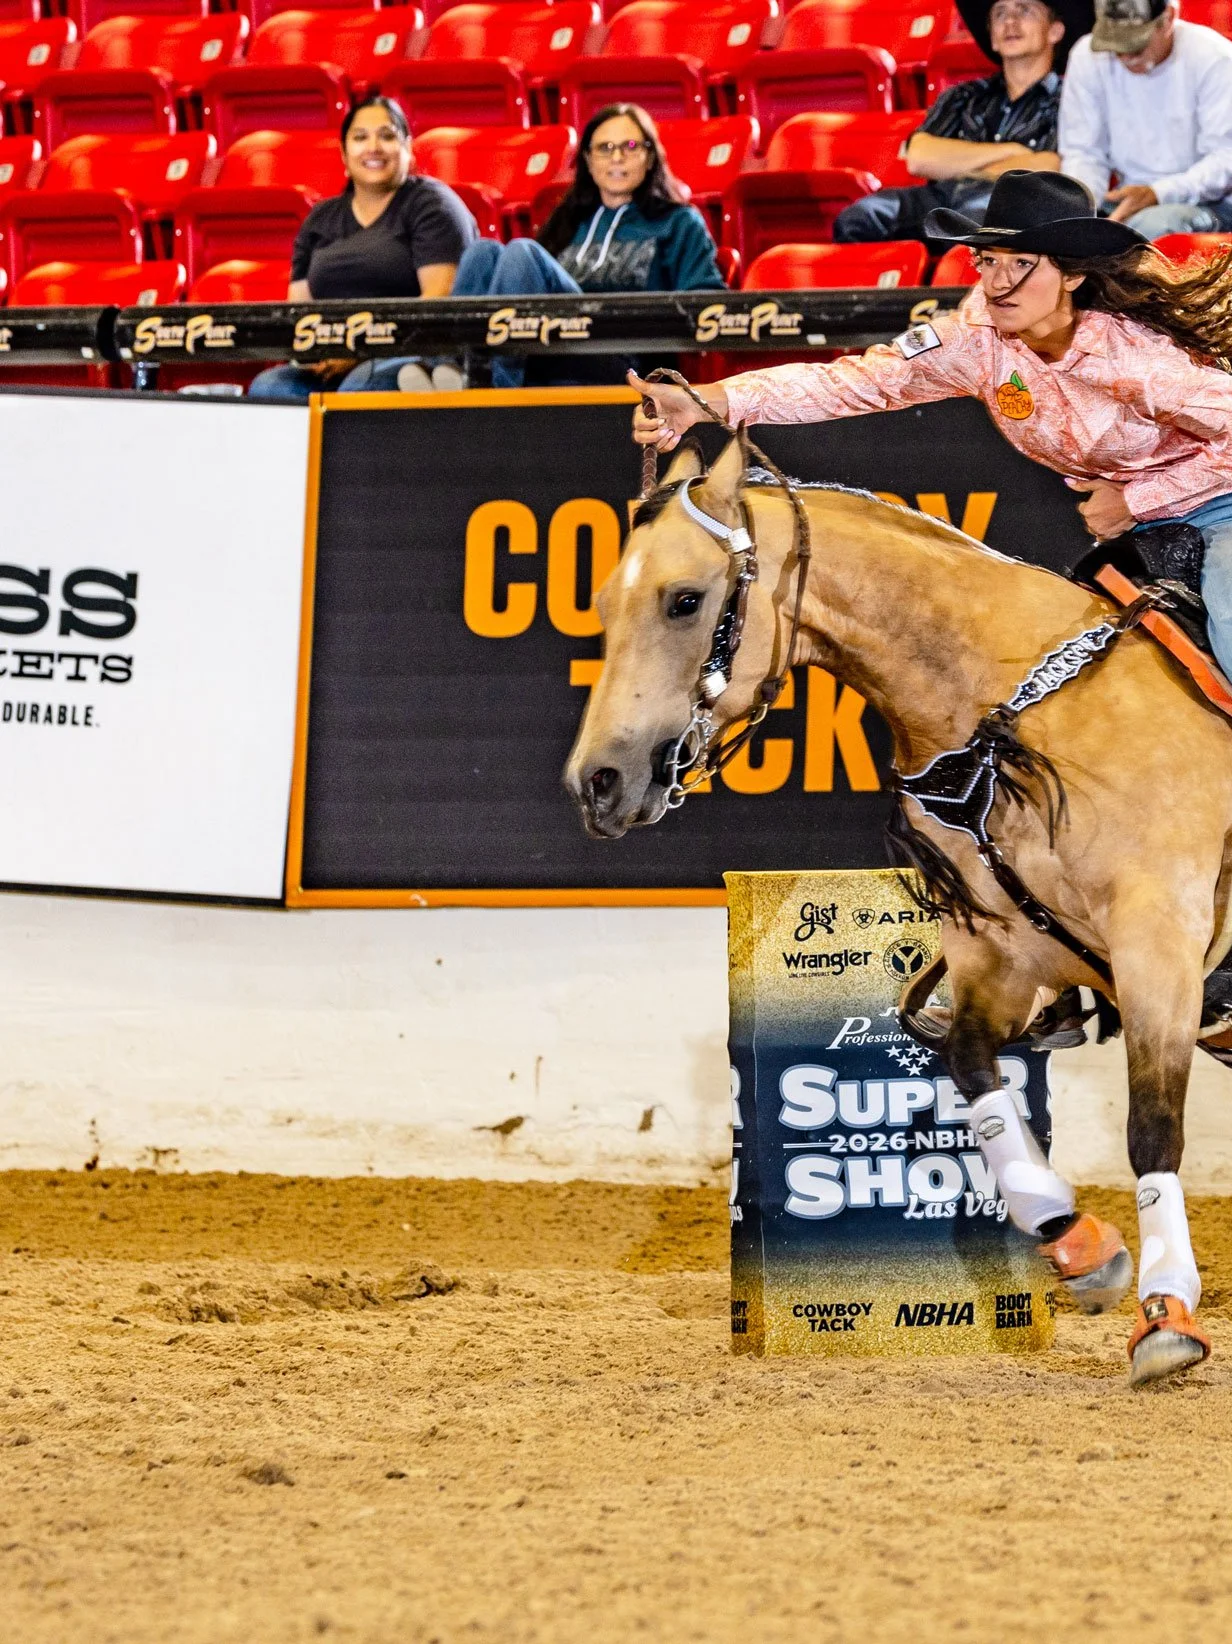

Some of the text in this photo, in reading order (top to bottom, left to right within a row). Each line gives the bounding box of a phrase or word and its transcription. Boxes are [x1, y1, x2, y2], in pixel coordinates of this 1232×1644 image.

[749, 302, 803, 342] POINT
[0, 651, 134, 684] ETS
[794, 902, 839, 942] Gist
[877, 910, 943, 925] ARIA
[782, 949, 872, 976] Wrangler
[825, 1016, 915, 1050] Profession
[828, 1129, 981, 1153] 2026 NBH
[903, 1190, 1009, 1222] Las Veg
[792, 1303, 873, 1319] COWBOY
[895, 1302, 975, 1327] NBHA
[995, 1293, 1032, 1311] BOOT
[808, 1318, 857, 1332] TACK
[995, 1310, 1032, 1329] BARN
